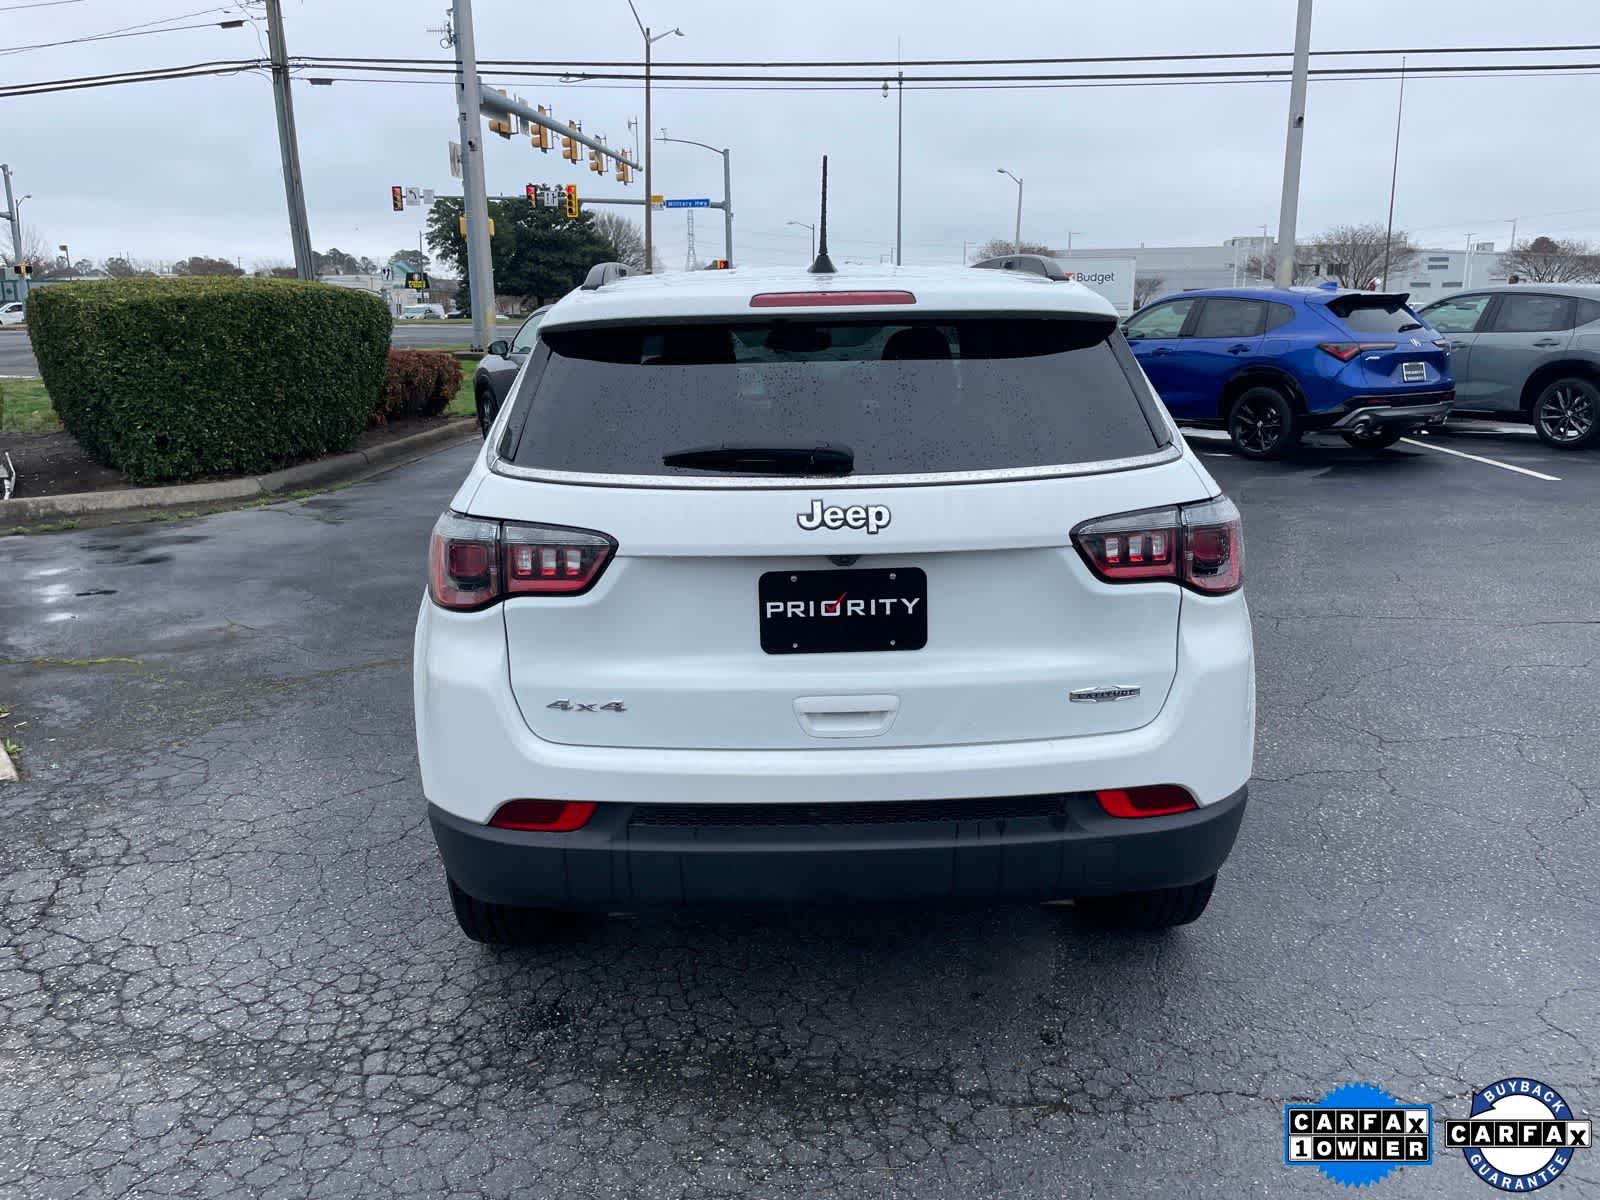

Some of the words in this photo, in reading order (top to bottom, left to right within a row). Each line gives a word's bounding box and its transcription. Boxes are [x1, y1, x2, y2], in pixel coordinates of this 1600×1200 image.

[1076, 272, 1115, 284] Budget
[797, 499, 891, 534] Jeep
[766, 597, 920, 619] PRIORITY
[546, 698, 627, 712] 4x4
